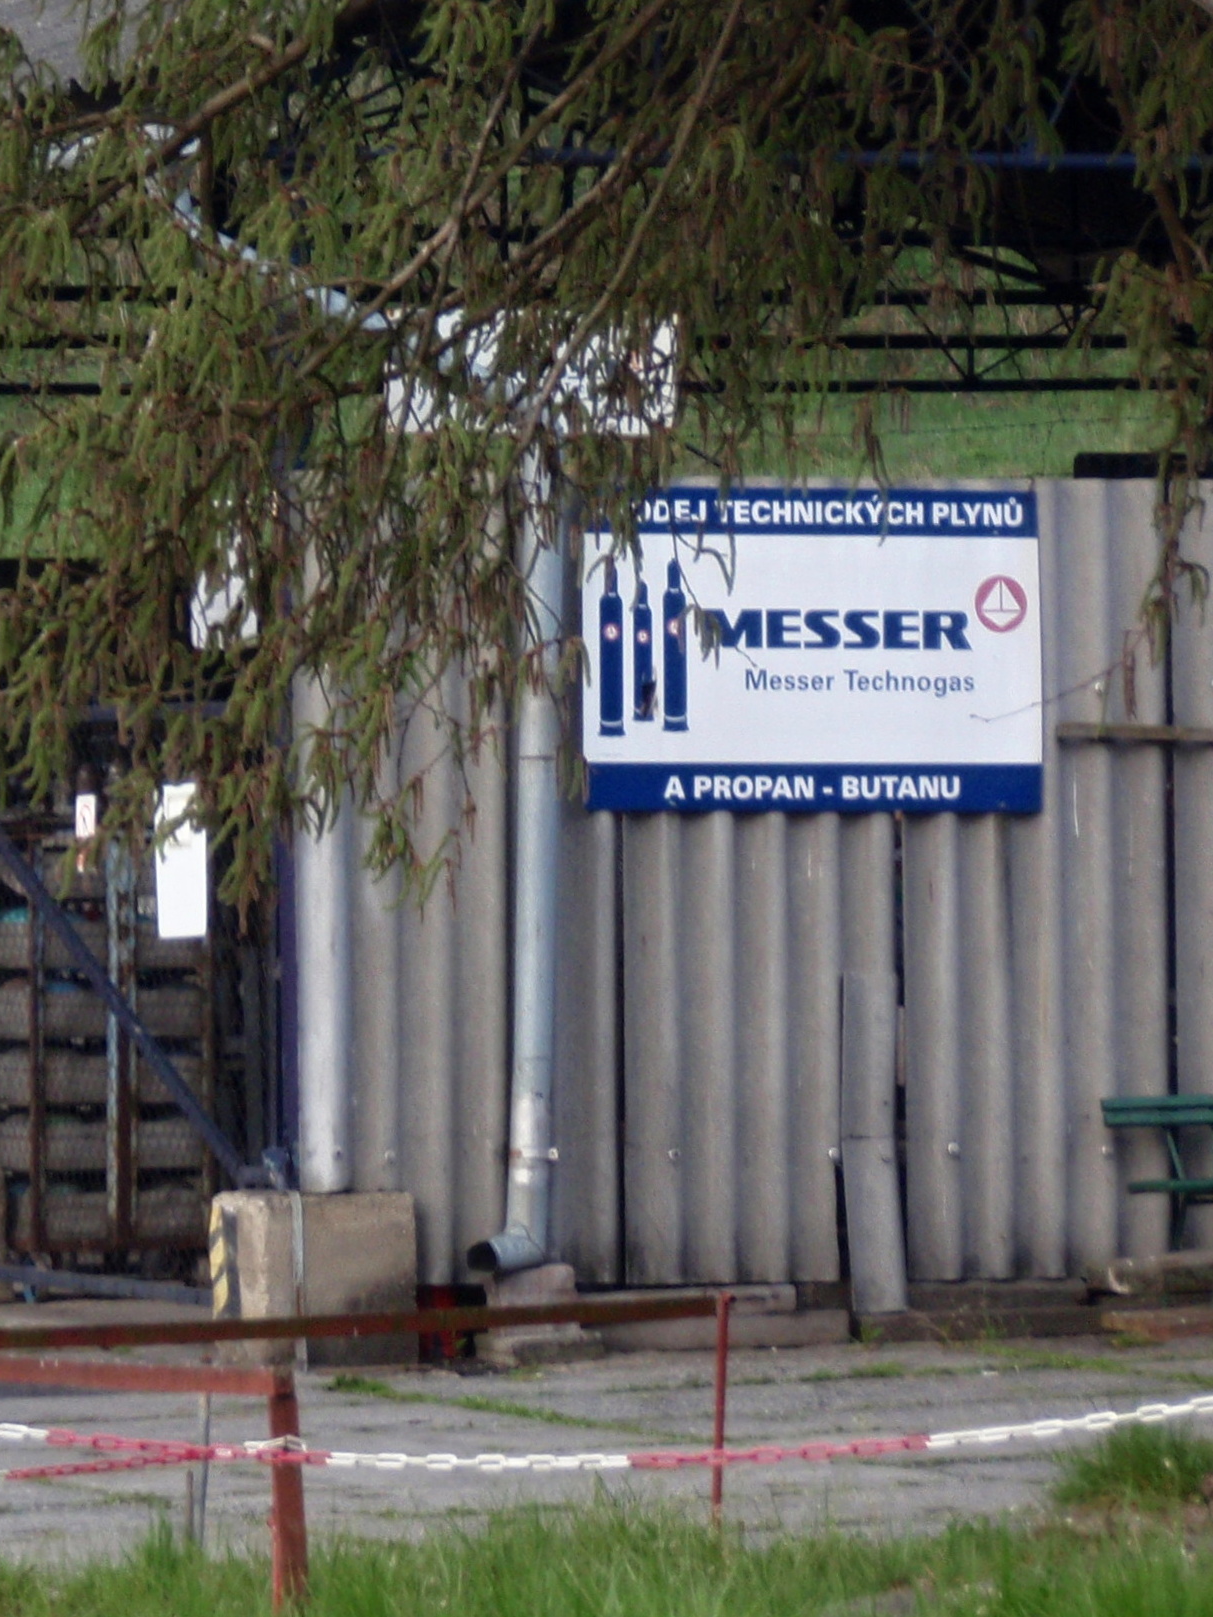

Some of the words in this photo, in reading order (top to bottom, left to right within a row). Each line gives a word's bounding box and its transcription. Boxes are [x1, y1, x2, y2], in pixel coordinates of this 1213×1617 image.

[716, 494, 925, 525] TECHNICKÝCH
[932, 497, 1023, 527] PLYNŮ
[704, 609, 972, 650] MESSER
[744, 669, 835, 692] Messer
[844, 670, 976, 698] Technogas
[664, 776, 685, 799] A
[693, 776, 815, 800] PROPAN
[841, 776, 961, 799] BUTANU
